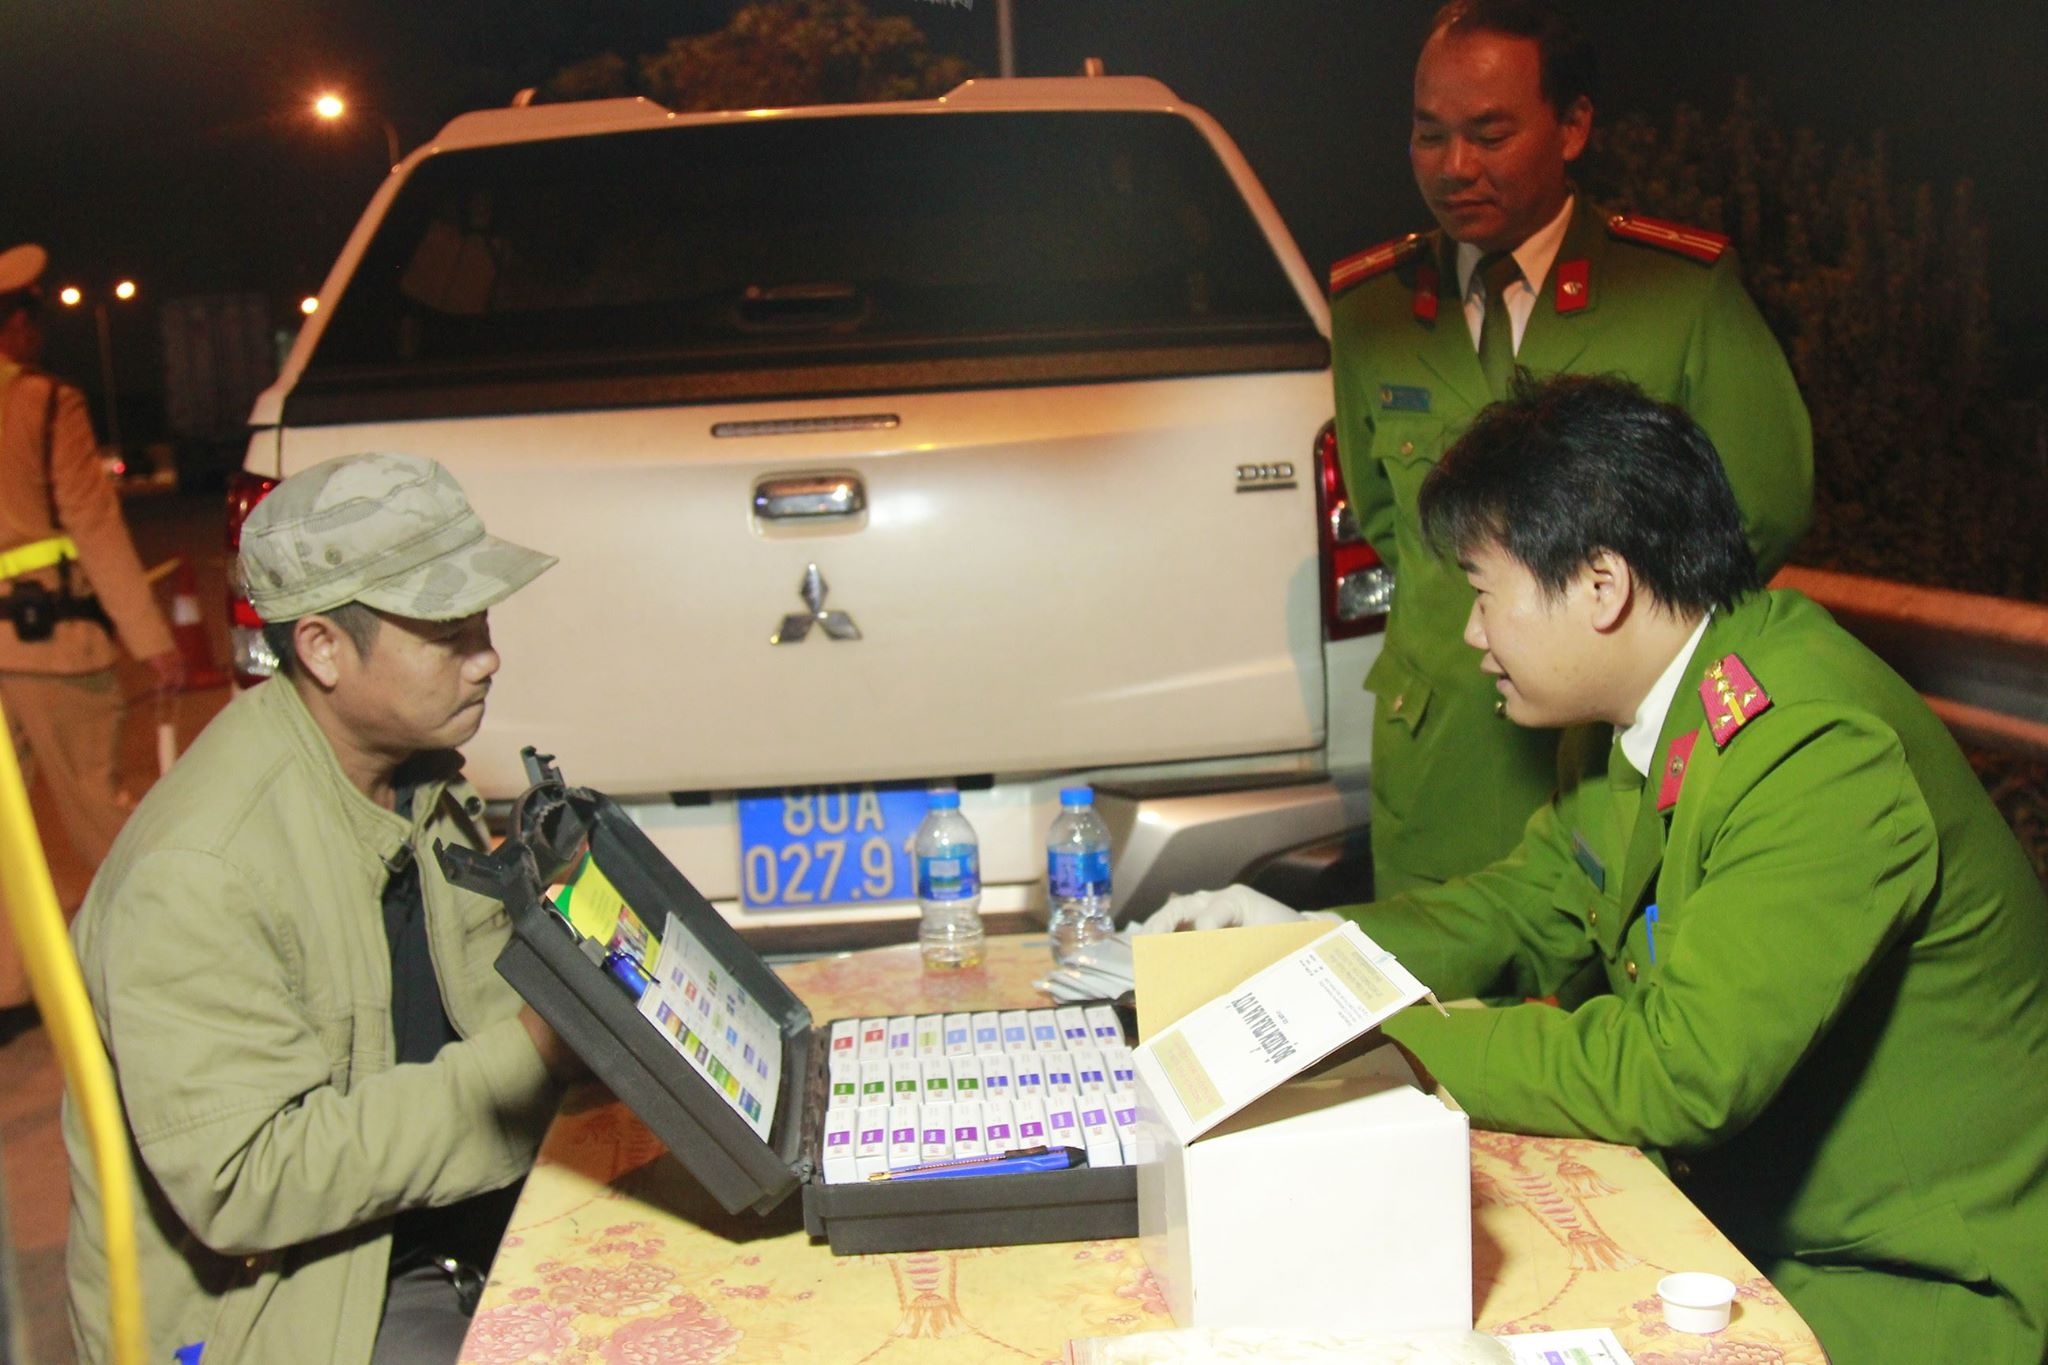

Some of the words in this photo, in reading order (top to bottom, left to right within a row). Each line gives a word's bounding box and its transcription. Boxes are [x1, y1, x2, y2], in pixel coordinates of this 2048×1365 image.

[782, 790, 885, 836] 80A
[1242, 1004, 1267, 1025] MA
[1250, 1014, 1277, 1038] TRA
